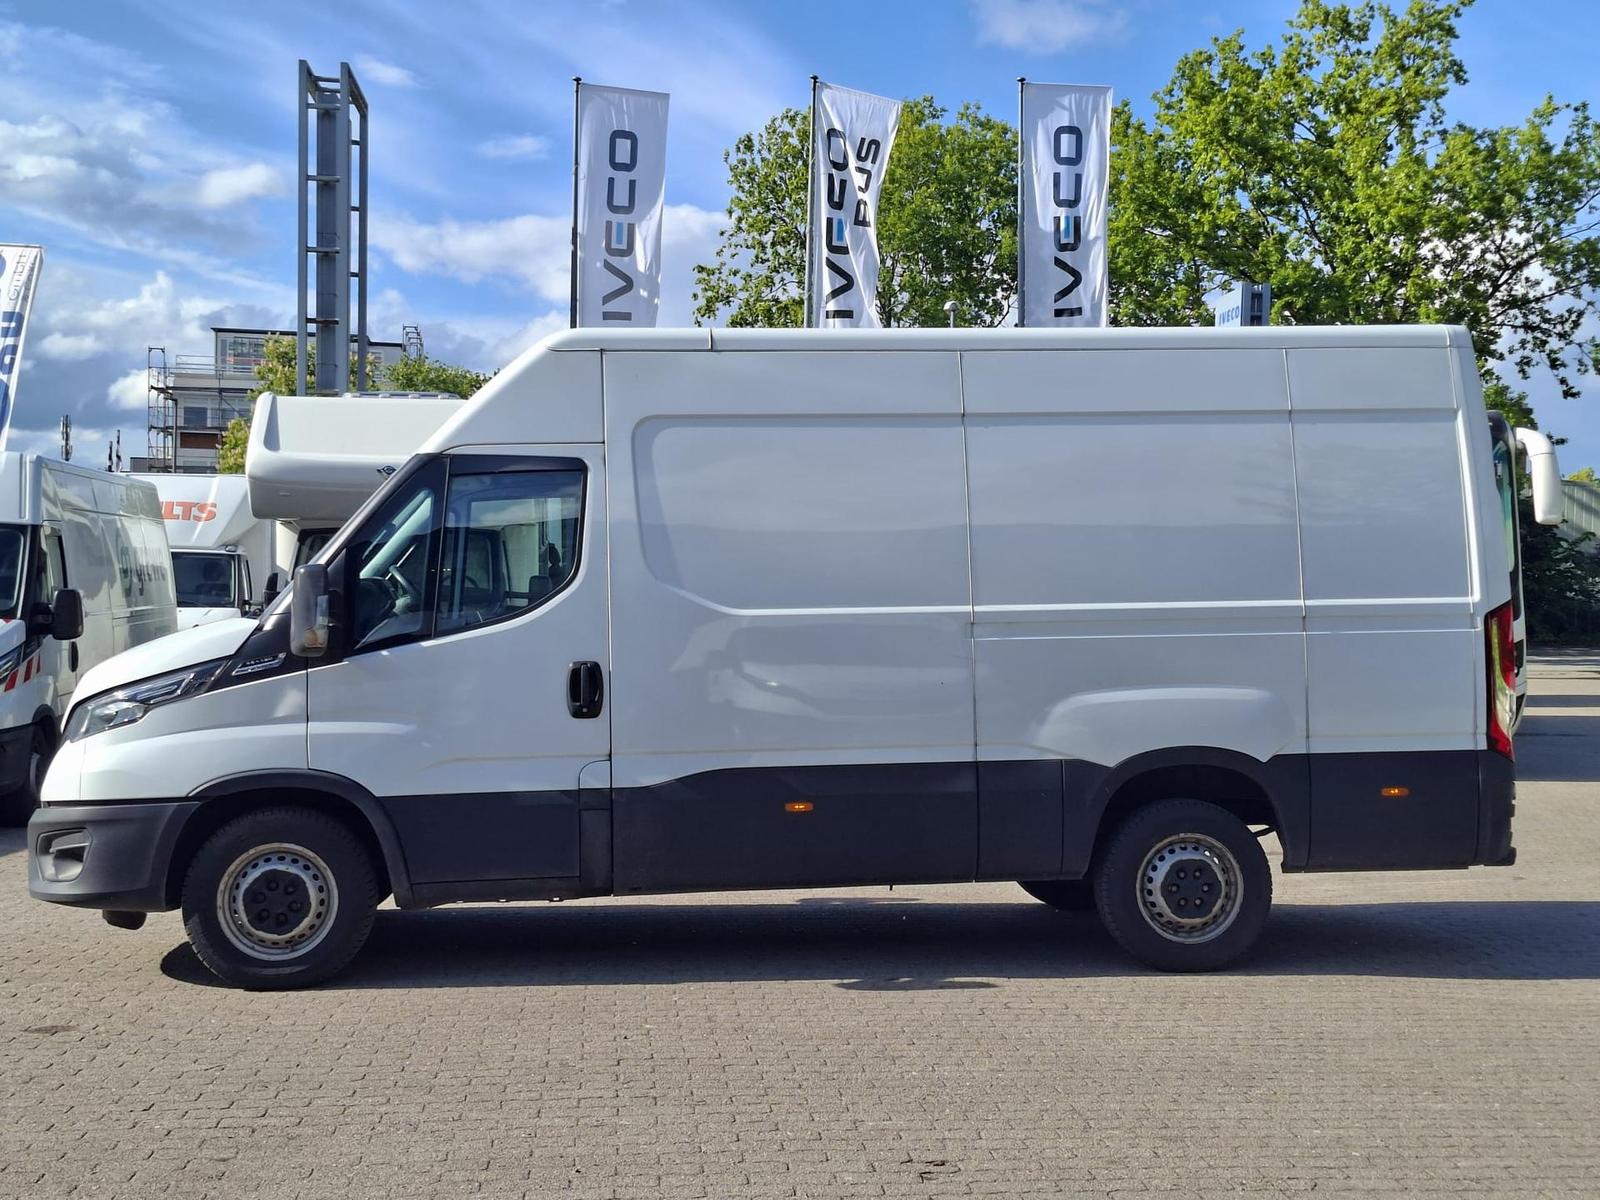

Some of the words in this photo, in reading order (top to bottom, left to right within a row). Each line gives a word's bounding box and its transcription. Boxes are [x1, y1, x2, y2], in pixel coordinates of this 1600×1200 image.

[602, 129, 638, 321] IVECO
[825, 127, 855, 320] IVECO
[853, 136, 881, 228] BUS
[1053, 125, 1083, 318] IVECO
[1218, 305, 1240, 327] IVECO
[161, 501, 217, 522] LTS
